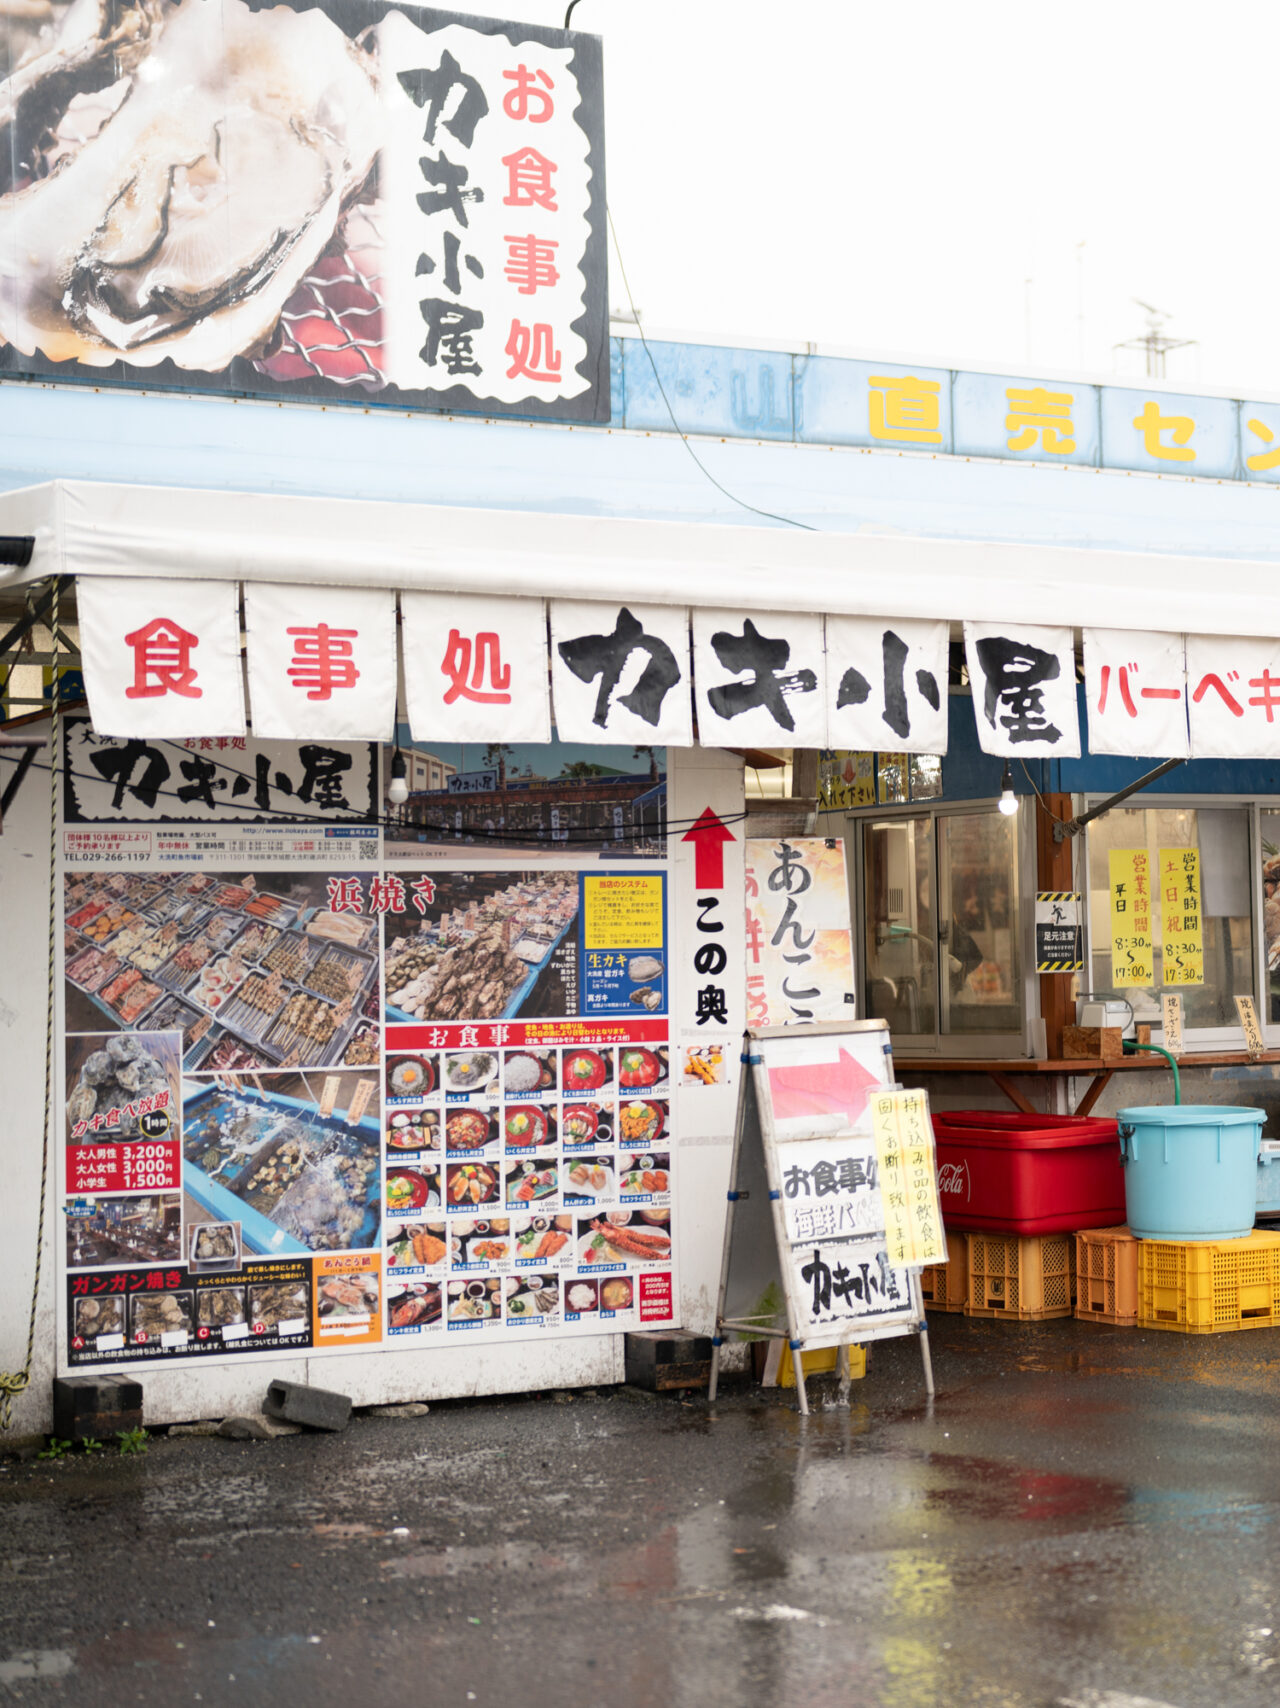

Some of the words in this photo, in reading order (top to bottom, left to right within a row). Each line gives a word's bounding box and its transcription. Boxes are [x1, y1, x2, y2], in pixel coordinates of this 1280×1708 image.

[396, 49, 489, 377] カキ小屋
[502, 64, 562, 383] お食事処
[125, 617, 511, 705] 食事処
[558, 607, 1063, 744] カキ小屋
[183, 737, 247, 751] お食事処
[90, 739, 352, 810] カキ小屋
[64, 853, 150, 862] TEL.029-266-1197
[326, 874, 438, 916] 浜焼き
[600, 880, 648, 888] 当店のシステム
[1132, 854, 1148, 933] 営業時間
[1182, 852, 1198, 931] 営業時間
[1115, 884, 1126, 912] 平日
[1044, 931, 1075, 942] 足元注意
[588, 954, 628, 968] 生カキ
[694, 897, 728, 1025] この奥
[428, 1025, 510, 1047] お食事
[71, 1090, 169, 1138] カキ食べ放題
[144, 1115, 168, 1130] 1時間
[76, 1148, 117, 1160] 大人男性
[123, 1145, 173, 1160] 3,200円
[76, 1162, 117, 1175] 大人女性
[123, 1159, 173, 1174] 3,000円
[904, 1096, 936, 1258] 持ち込み品の飲食は
[76, 1178, 107, 1189] 小学生
[123, 1173, 173, 1188] 1,500円
[878, 1098, 905, 1262] 固くお断り致します
[72, 1270, 182, 1295] ガンガン焼き
[802, 1250, 901, 1315] カキ小屋
[139, 1332, 146, 1342] B
[200, 1328, 208, 1338] C
[255, 1324, 264, 1334] D
[74, 1338, 82, 1346] A
